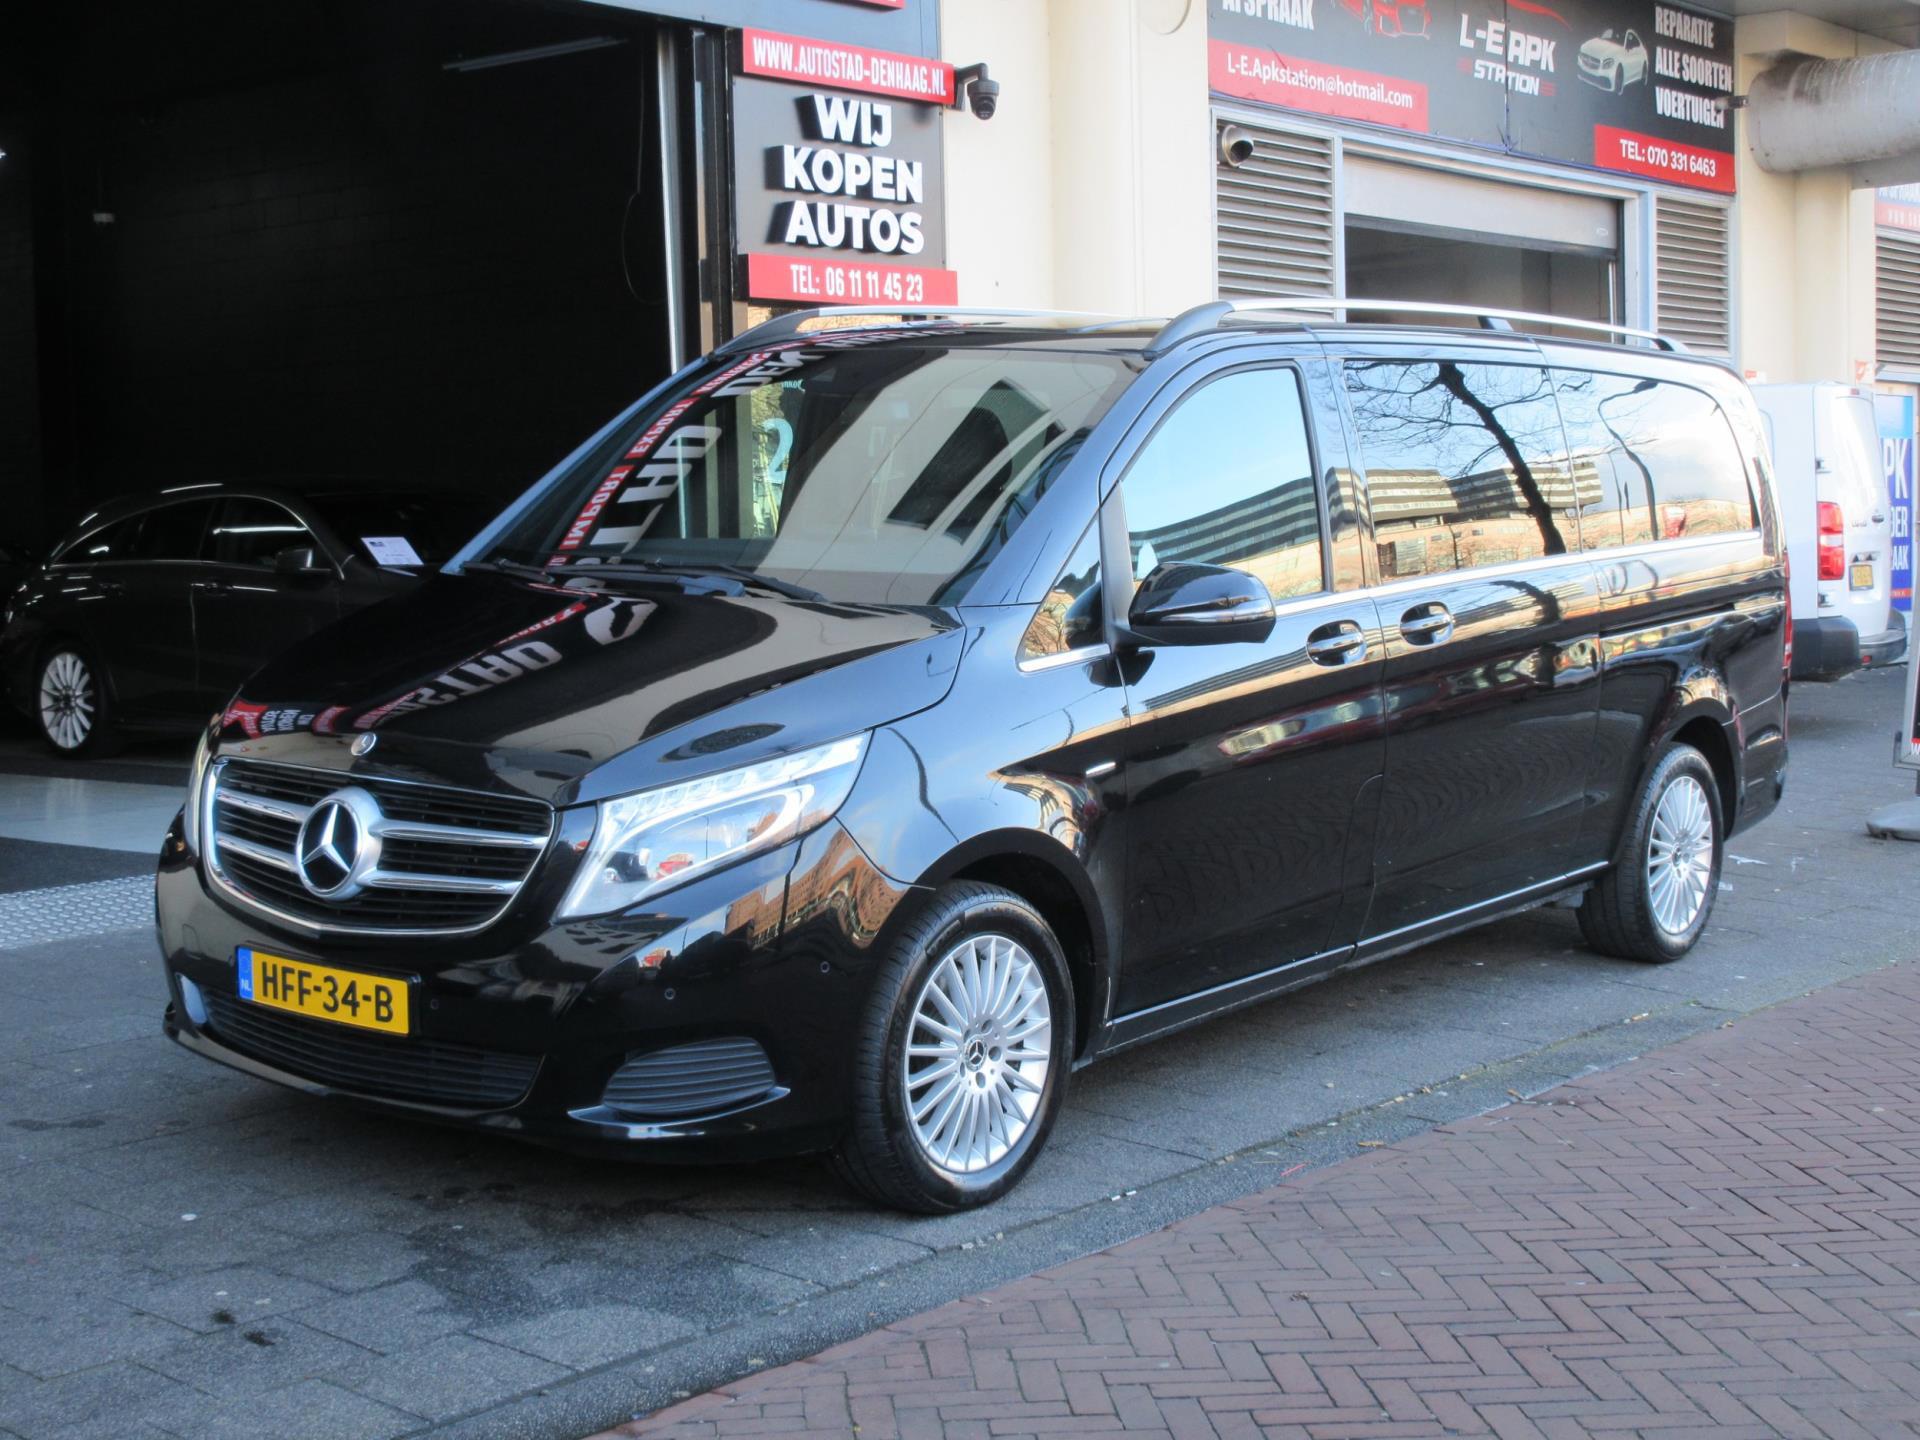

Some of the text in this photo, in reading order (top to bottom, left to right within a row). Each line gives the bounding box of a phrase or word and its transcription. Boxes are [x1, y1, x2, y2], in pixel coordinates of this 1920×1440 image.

[1507, 30, 1557, 73] APK
[1655, 6, 1715, 48] REPARATIE
[753, 38, 946, 97] WWW.AUTOSTAD-DENHAAG.NL
[1227, 52, 1413, 108] L-E.Apkstation@hotmail.com
[1474, 59, 1540, 96] STATION
[1655, 48, 1732, 92] ALLE SOORTEN
[814, 94, 893, 147] WIJ
[783, 144, 923, 203] KOPEN
[1620, 139, 1716, 177] TEL: 070 331 6463
[785, 200, 925, 255] AUTOS
[791, 264, 923, 302] TEL: 06 11 11 45 23
[1883, 438, 1908, 499] PK
[262, 961, 393, 1023] HFF-34-B
